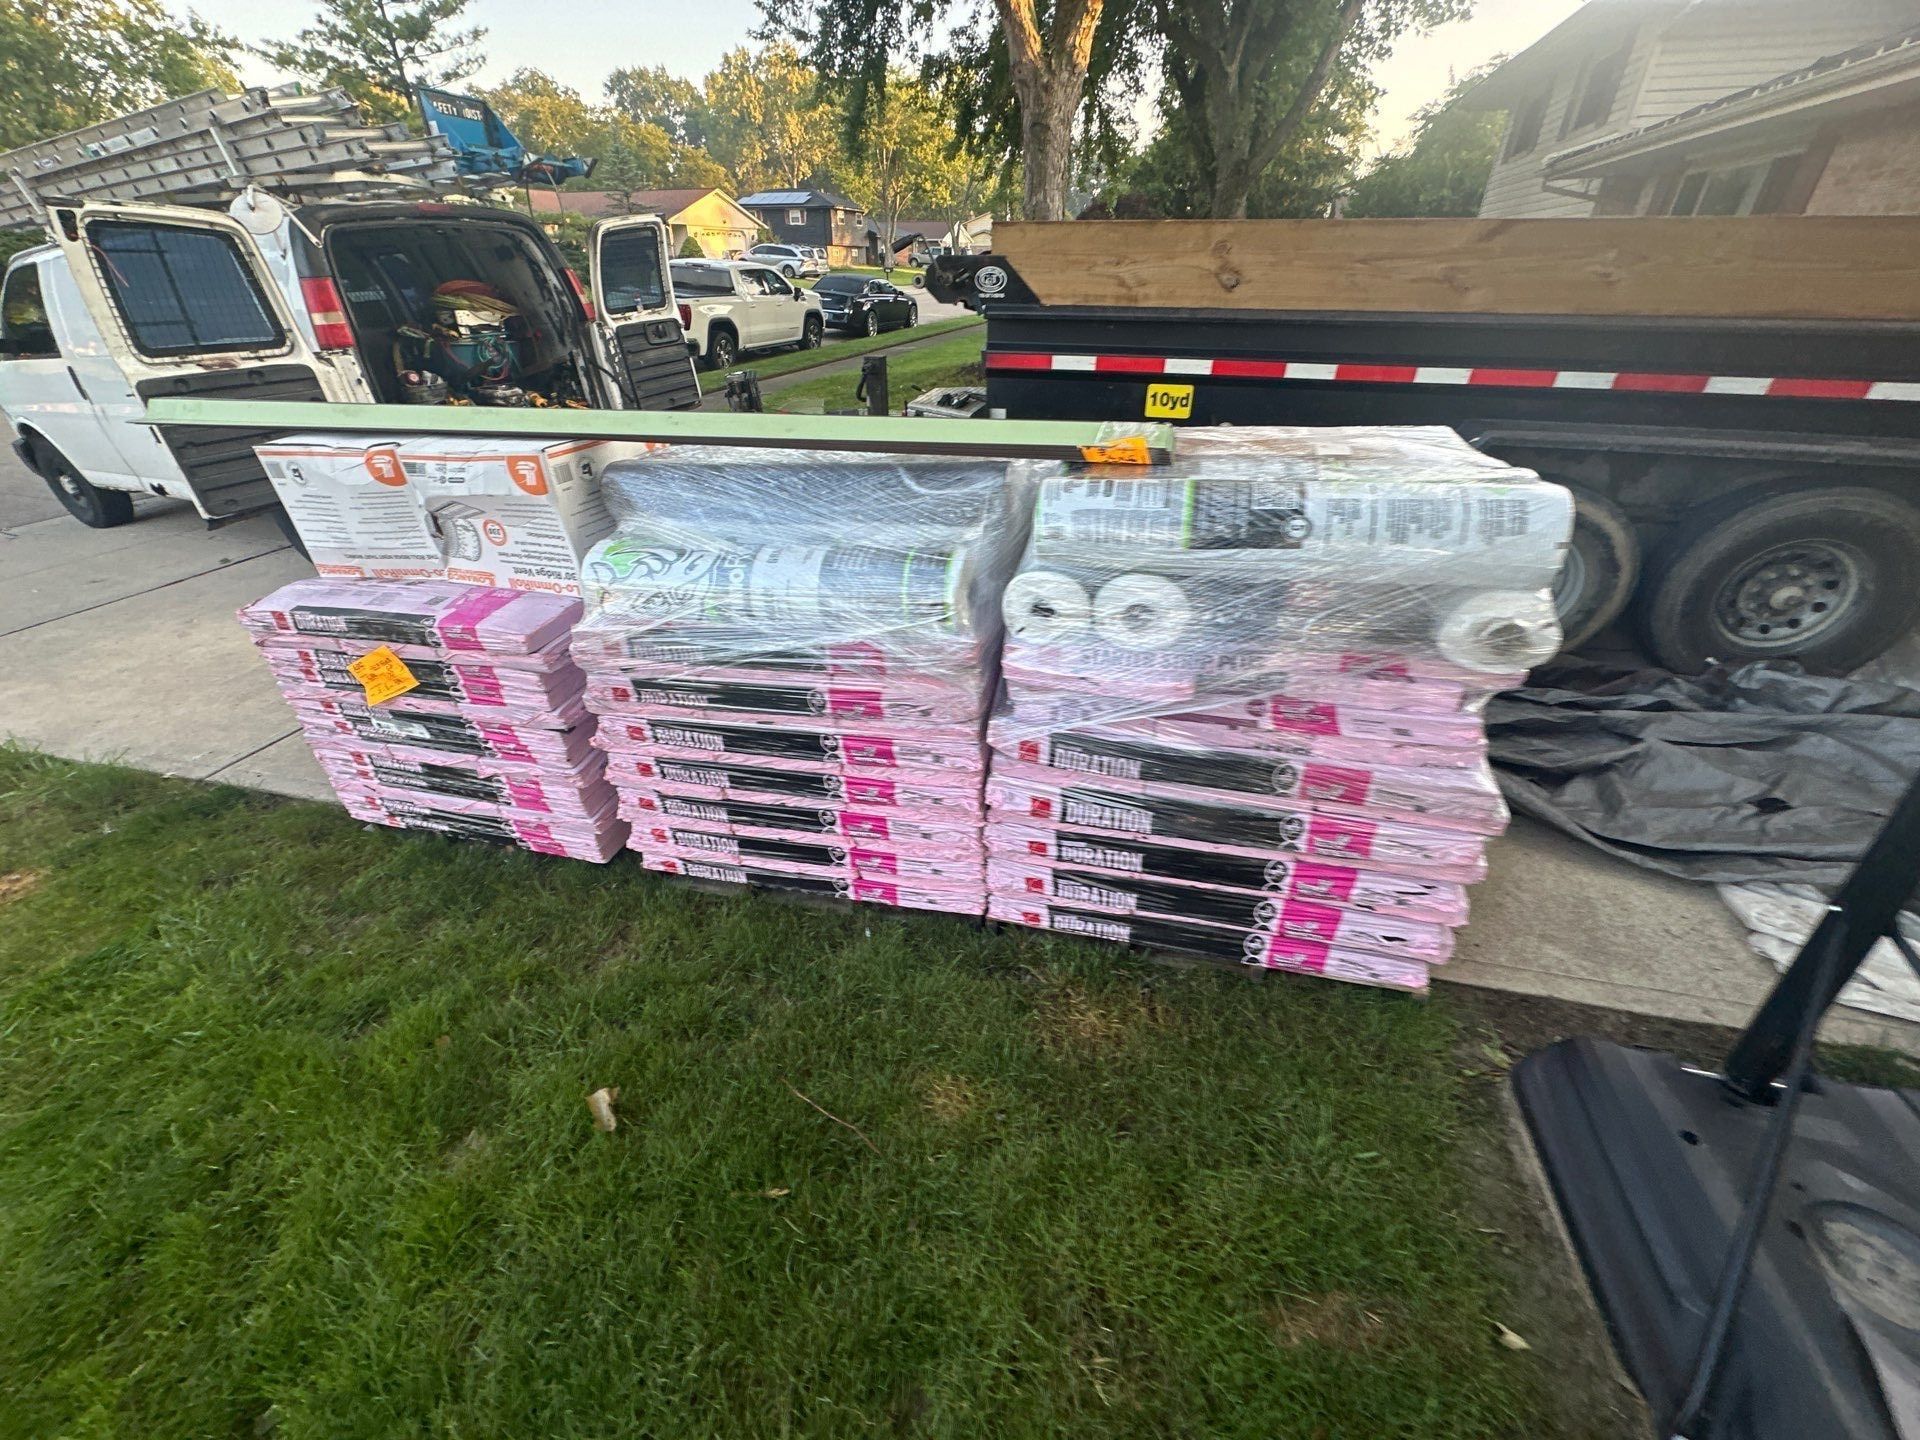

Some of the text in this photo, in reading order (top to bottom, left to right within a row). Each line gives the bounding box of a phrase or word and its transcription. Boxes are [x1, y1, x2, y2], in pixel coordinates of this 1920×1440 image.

[1151, 392, 1190, 410] 10yd
[512, 566, 535, 577] Vent
[535, 568, 562, 580] Ridge
[508, 577, 581, 596] Lo-OmniRoll
[1066, 801, 1153, 835] DURATION
